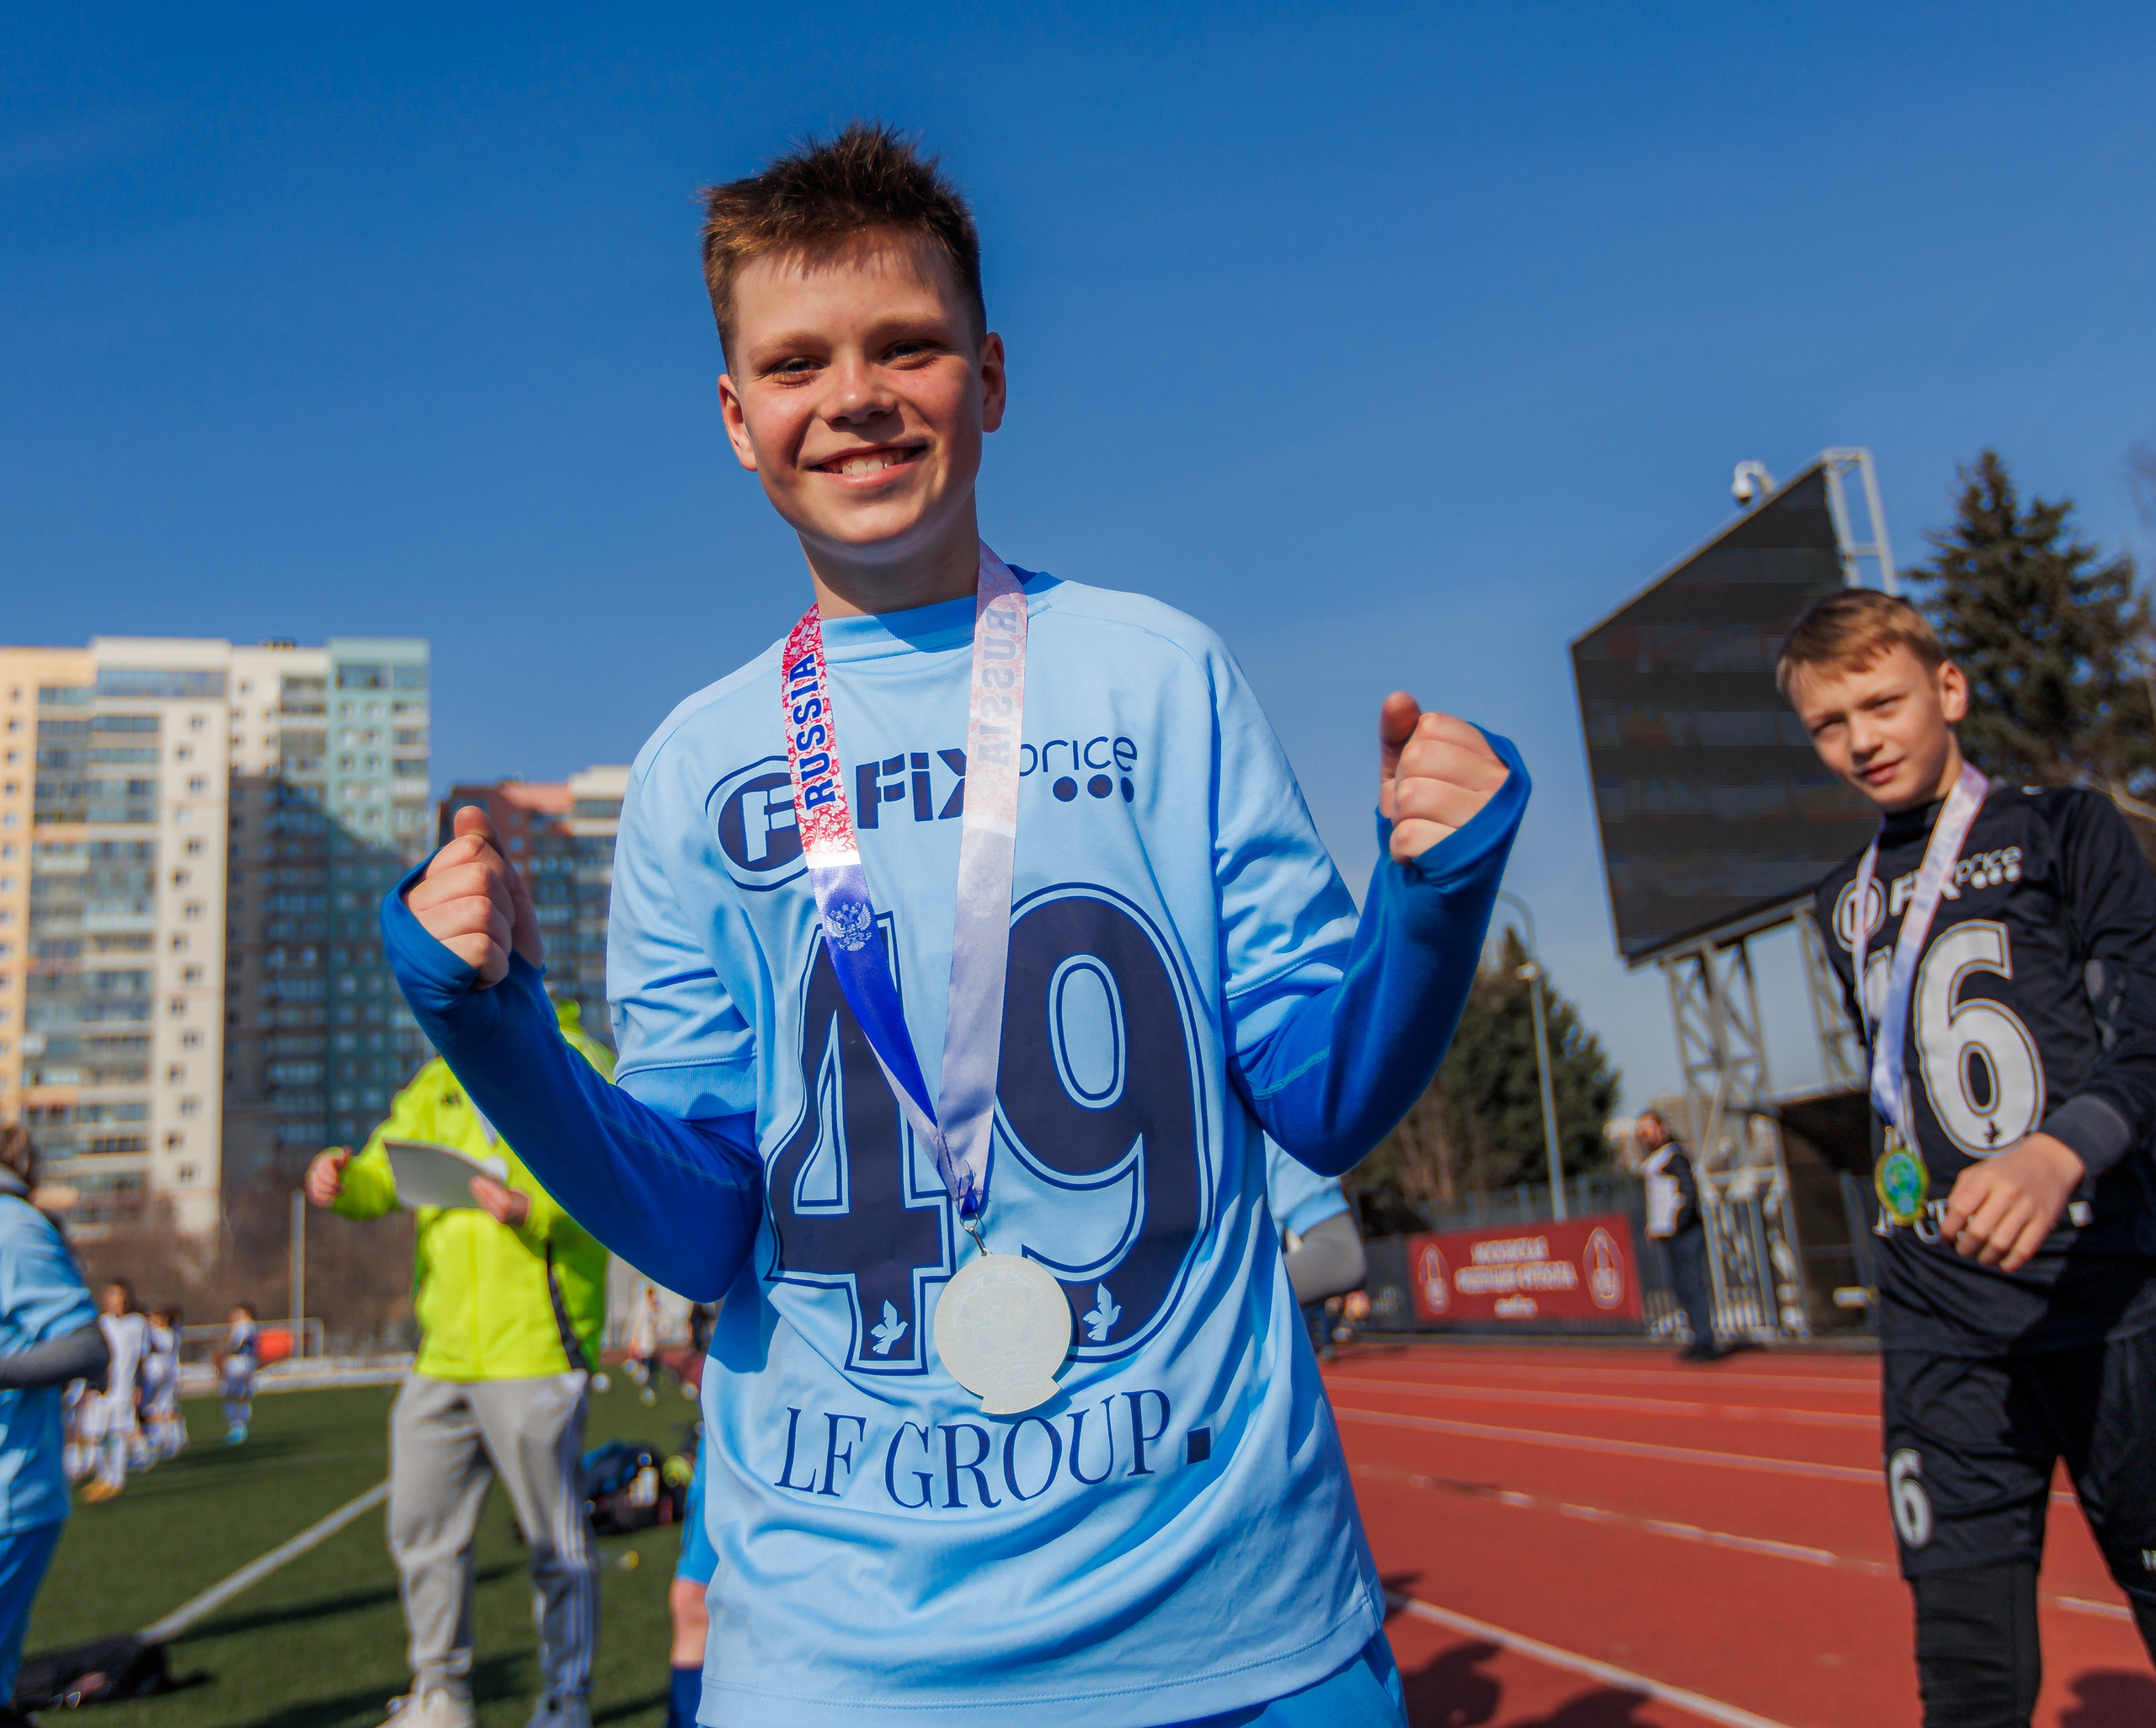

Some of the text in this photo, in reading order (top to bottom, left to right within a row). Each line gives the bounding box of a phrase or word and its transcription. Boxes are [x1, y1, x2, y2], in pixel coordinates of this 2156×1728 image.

[789, 653, 836, 812] RUSSIA
[763, 882, 1214, 1377] 49
[774, 1389, 1171, 1509] LF GROUP
